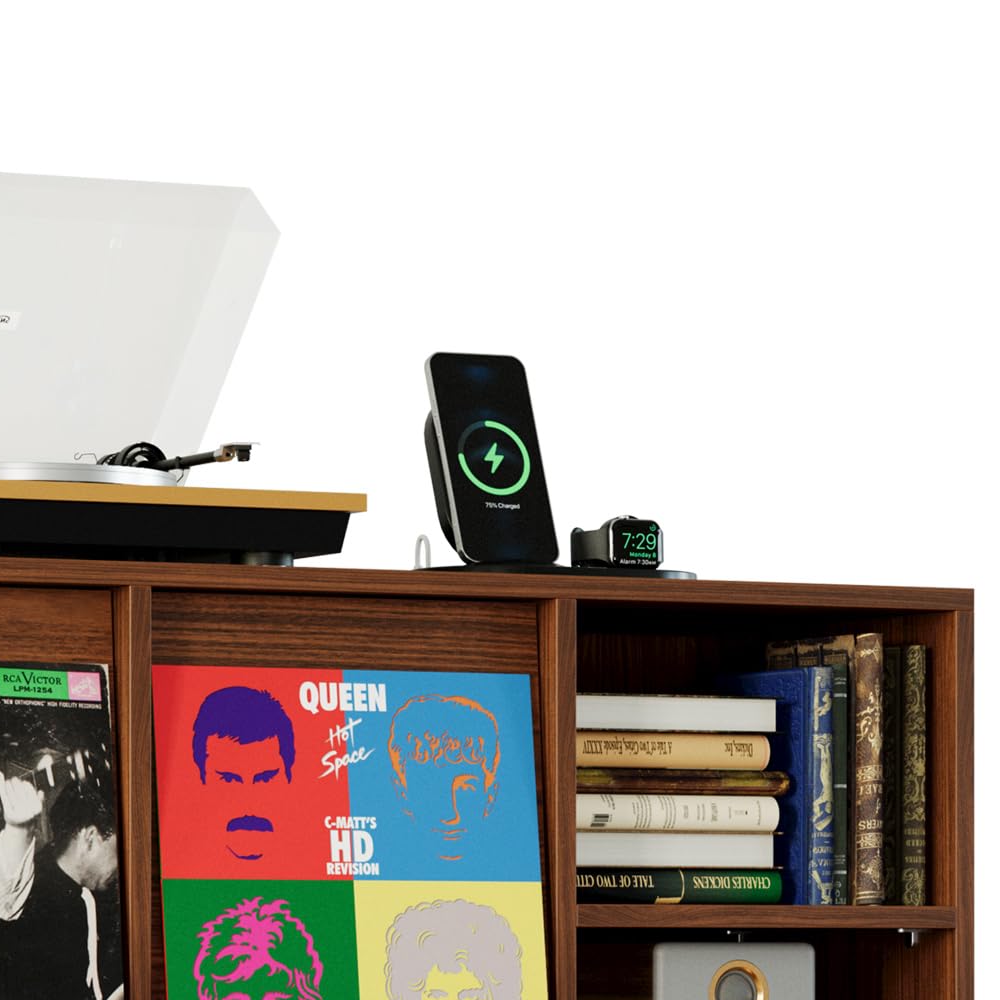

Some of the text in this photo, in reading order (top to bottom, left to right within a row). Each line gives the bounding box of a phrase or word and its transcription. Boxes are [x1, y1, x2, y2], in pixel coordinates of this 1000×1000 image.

[622, 532, 657, 550] 7:29
[3, 671, 62, 685] RCA VICTOR
[13, 685, 53, 694] LPM-1254
[299, 681, 387, 713] QUEEN
[324, 718, 362, 745] Hot
[317, 746, 376, 779] Space
[324, 816, 377, 830] C-MATT'S
[330, 830, 374, 863] HD
[326, 862, 380, 876] REVISION
[596, 875, 618, 888] TWO
[618, 875, 631, 888] OF
[632, 875, 655, 889] TALE
[692, 876, 771, 890] CHARLES DICKENS
